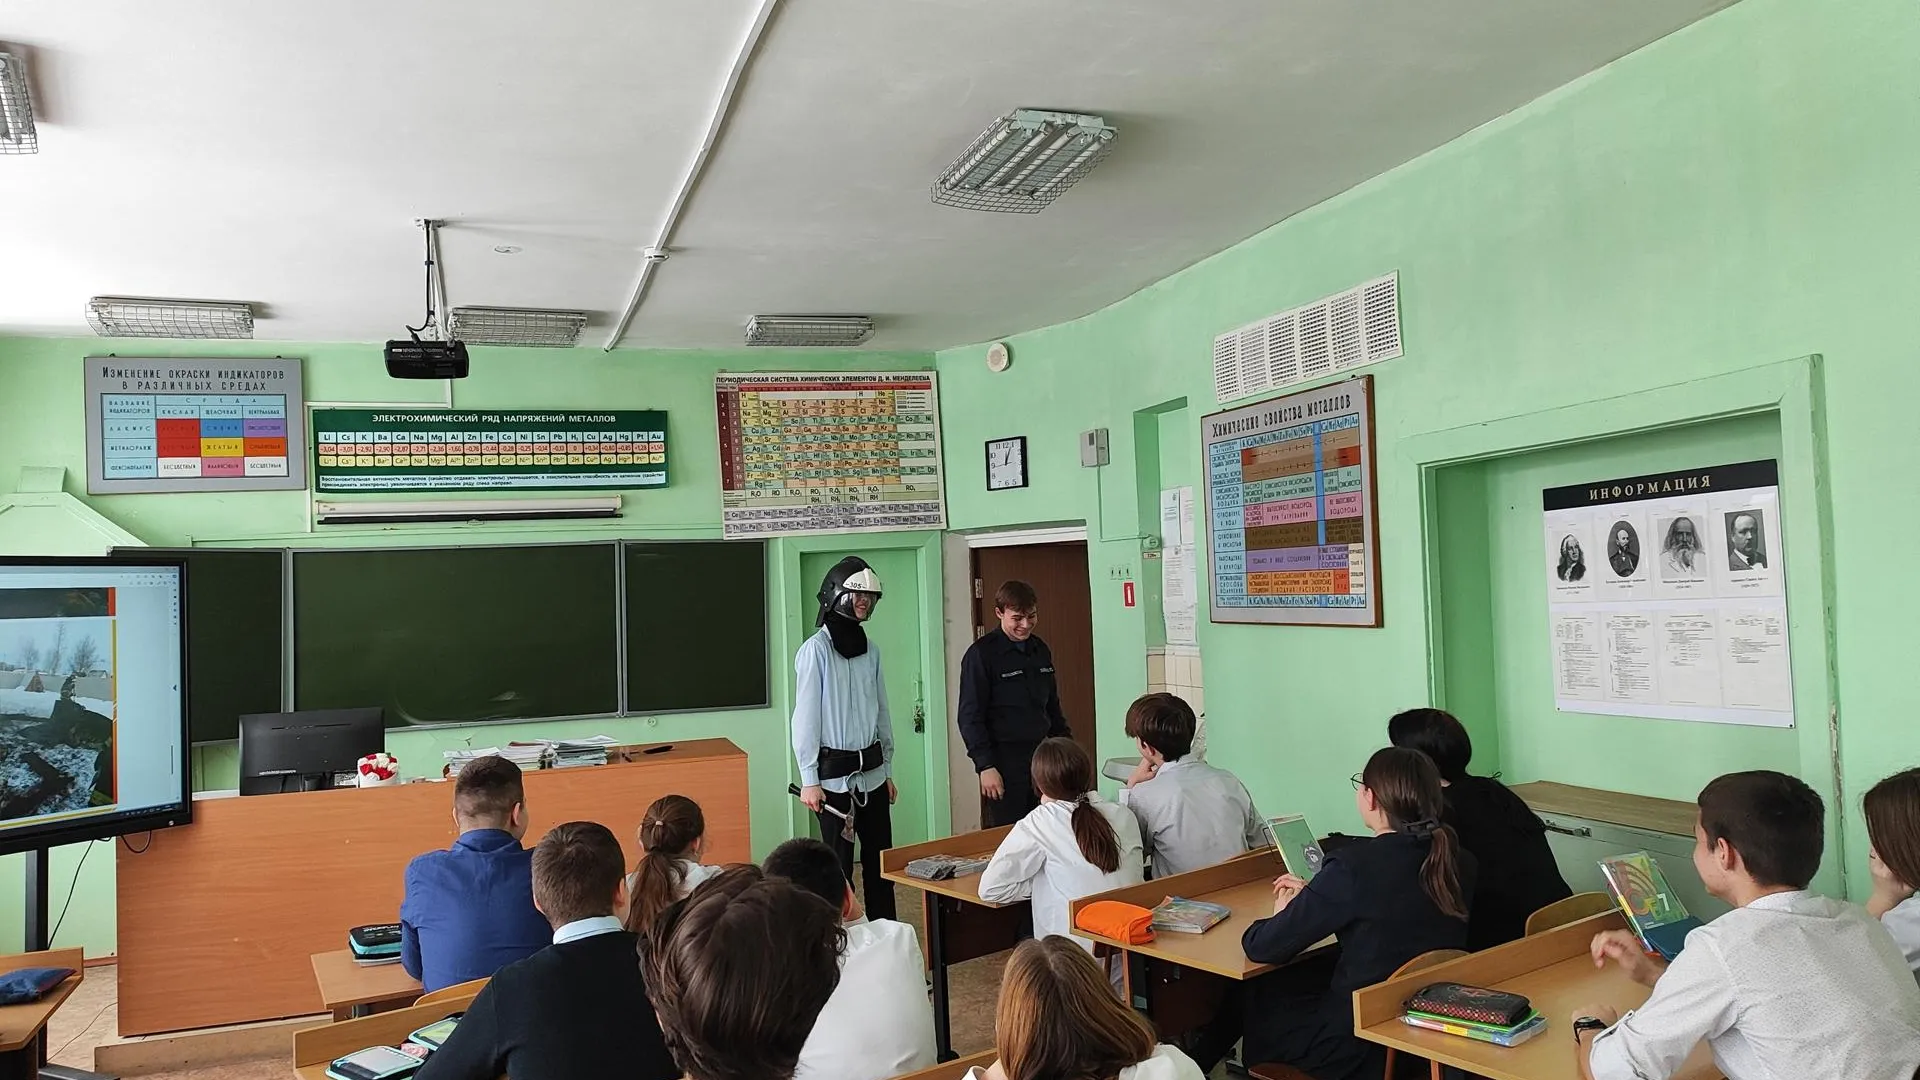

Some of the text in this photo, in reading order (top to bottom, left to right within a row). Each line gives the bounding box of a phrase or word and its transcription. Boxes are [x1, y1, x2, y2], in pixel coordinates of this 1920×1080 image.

[102, 367, 284, 380] ИЗМЕНЕНИЕ ОКРАСКИ ИНДИКАТОРОВ
[137, 381, 212, 390] РАЗЛИЧНЫХ
[221, 382, 266, 391] СРЕДАХ
[372, 413, 478, 423] ЭЛЕКТРОХИМИЧЕСКИЙ
[482, 415, 500, 423] РЯД
[504, 413, 565, 422] НАПРЯЖЕНИЙ
[1212, 415, 1259, 438] Химические
[1264, 405, 1302, 426] свойства
[1307, 394, 1350, 417] металлов
[1589, 475, 1710, 500] ИНФОРМАЦИЯ
